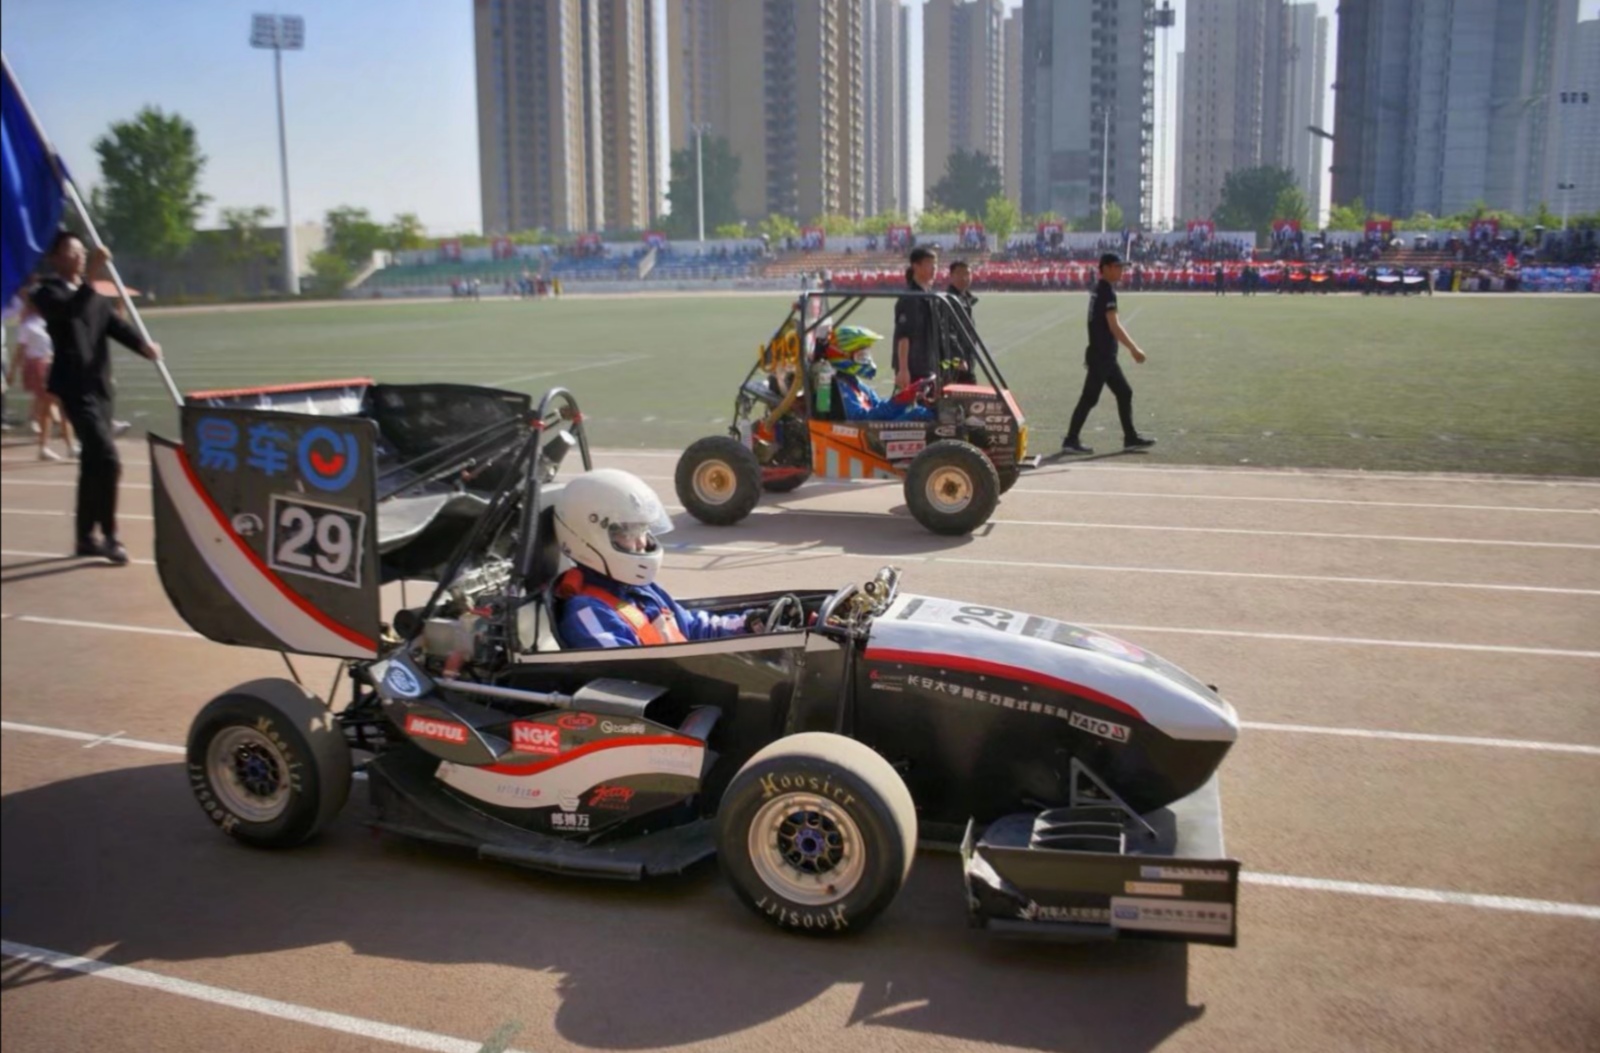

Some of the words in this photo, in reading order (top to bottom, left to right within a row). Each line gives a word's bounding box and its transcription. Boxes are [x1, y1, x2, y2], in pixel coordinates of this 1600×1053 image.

[196, 417, 289, 476] 易车
[277, 507, 353, 574] 29
[951, 606, 1014, 632] 29
[410, 718, 464, 742] MOTUL
[515, 727, 557, 746] NGK
[1072, 713, 1110, 735] YATO
[760, 772, 856, 806] Hoosier
[756, 896, 848, 930] Hoosier
